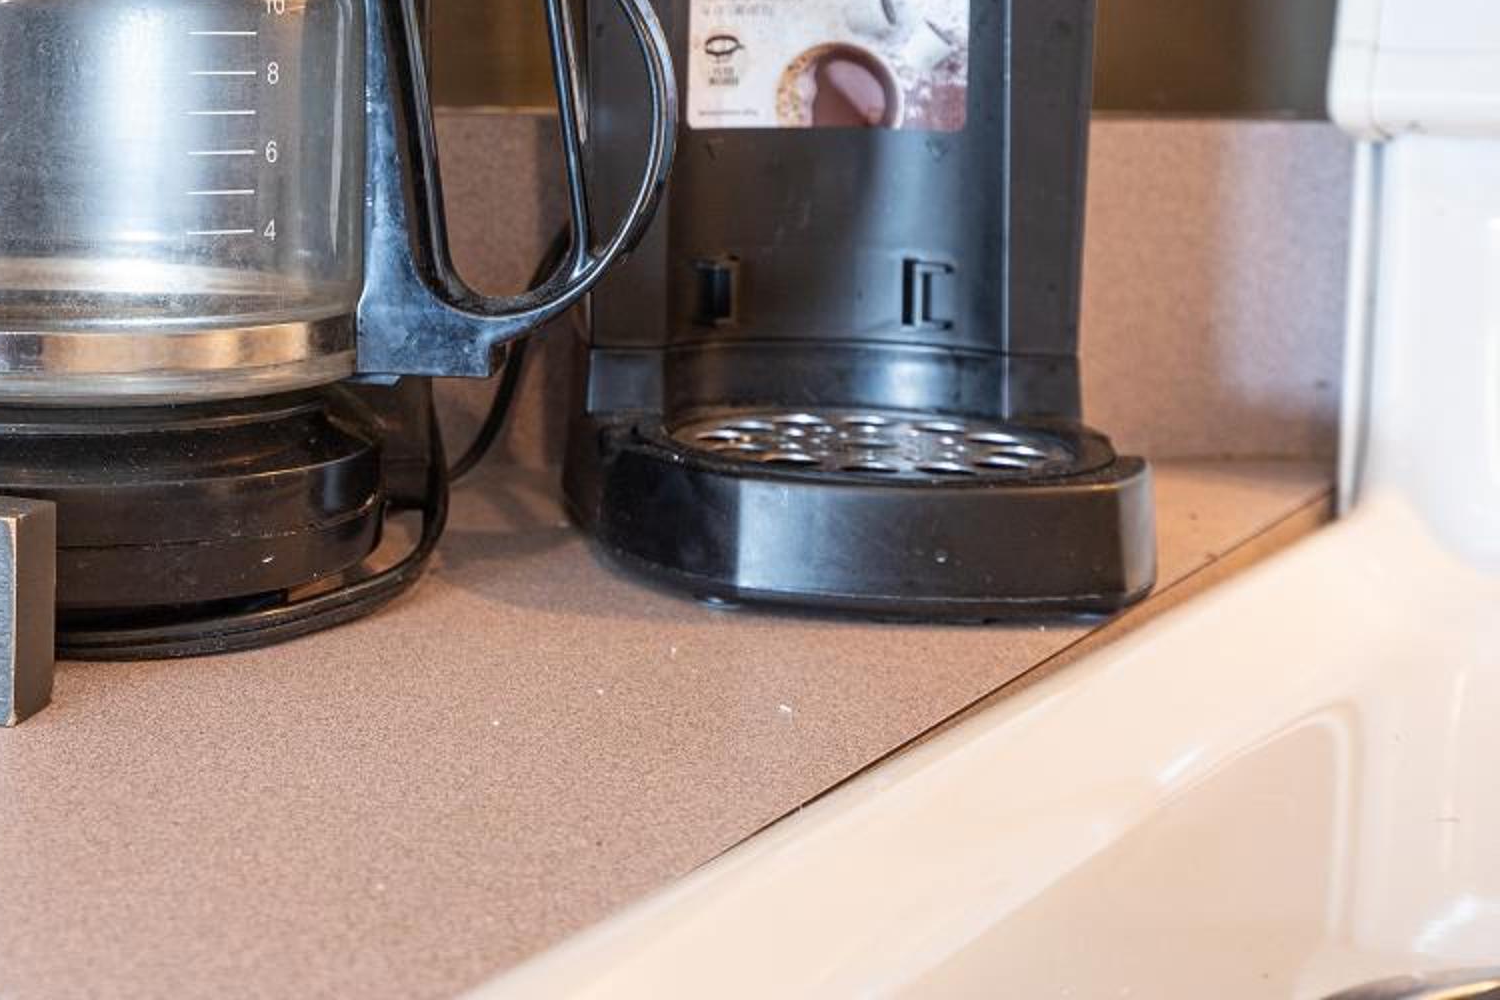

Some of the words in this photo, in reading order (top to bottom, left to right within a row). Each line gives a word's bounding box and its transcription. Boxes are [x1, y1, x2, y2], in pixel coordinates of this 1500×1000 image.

[266, 61, 279, 84] 8
[265, 141, 278, 163] 6
[263, 219, 277, 241] 4
